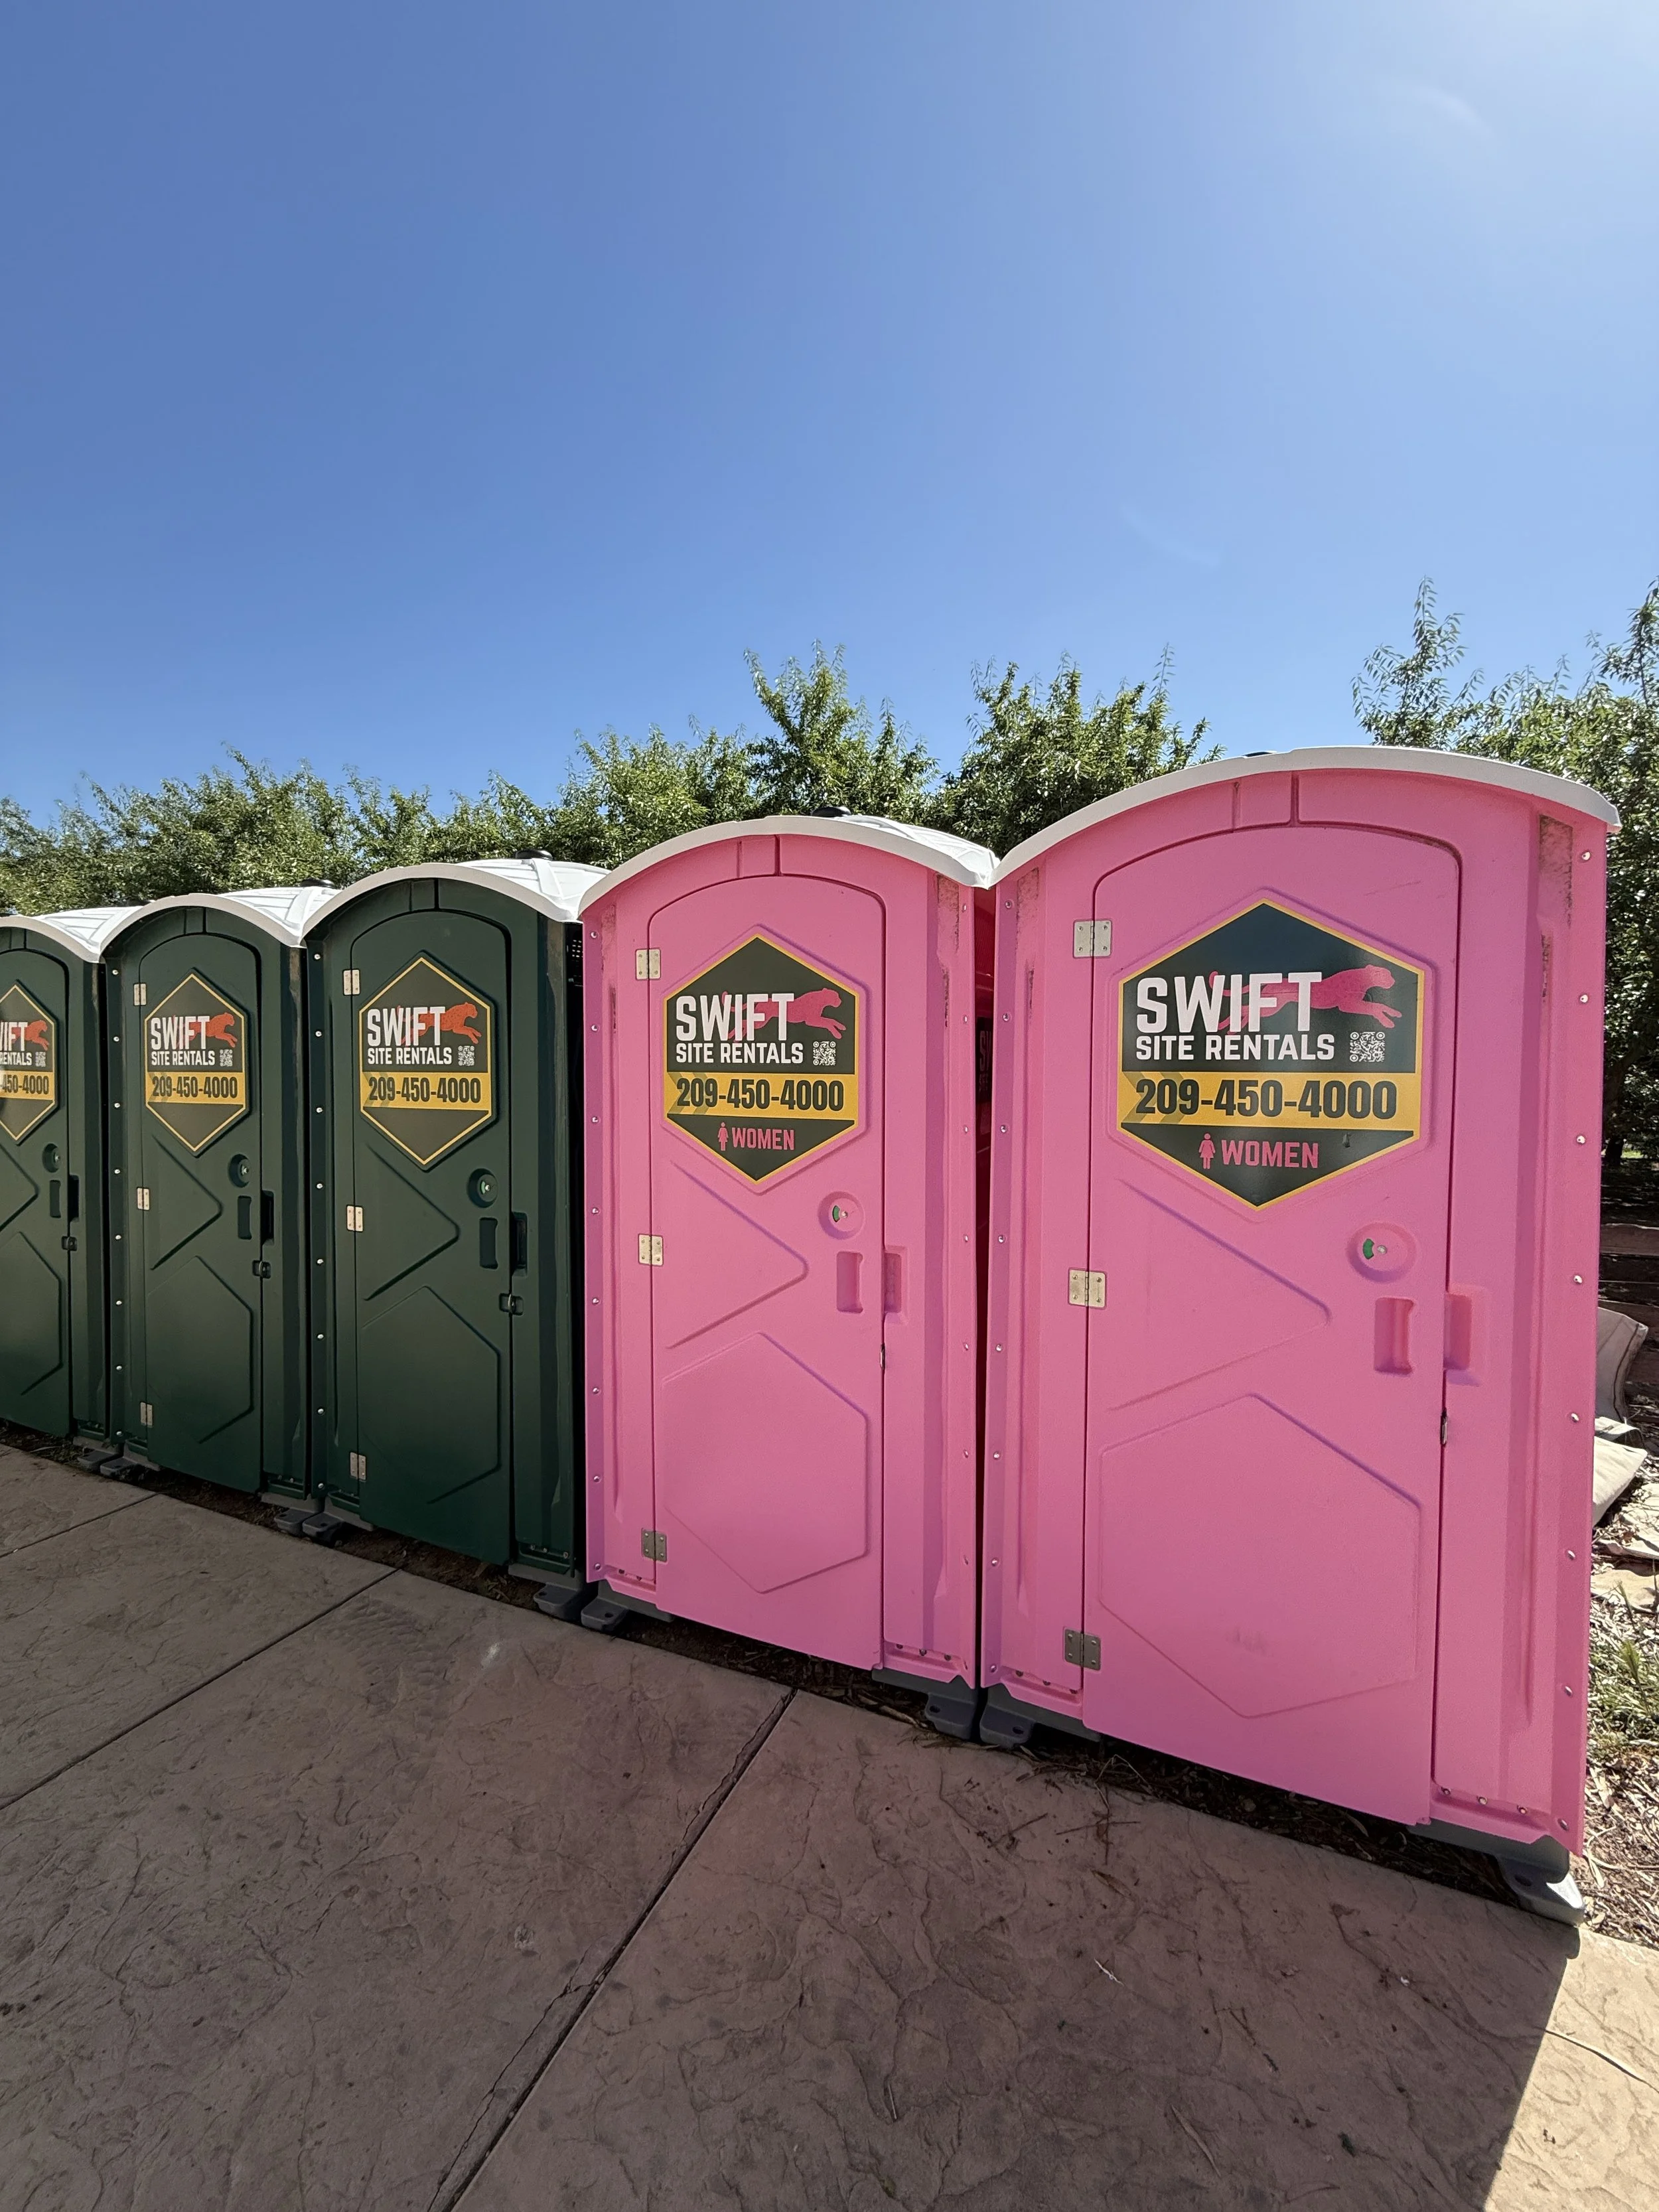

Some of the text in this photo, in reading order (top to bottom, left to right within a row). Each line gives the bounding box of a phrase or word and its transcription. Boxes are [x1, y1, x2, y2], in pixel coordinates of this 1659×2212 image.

[676, 993, 794, 1042] SWIFT
[1136, 972, 1323, 1034] SWIFT
[0, 1021, 29, 1052] IFT
[151, 1015, 210, 1050] SWIFT
[367, 1006, 446, 1047] SWIFT
[151, 1050, 216, 1066] SITE RENTALS
[367, 1046, 453, 1065] SITE RENTALS
[676, 1042, 804, 1065] SITE RENTALS
[1135, 1033, 1335, 1061] SITE RENTALS
[152, 1076, 238, 1098] 209-450-4000
[368, 1076, 482, 1104] 209-450-4000
[676, 1078, 844, 1112] 209-450-4000
[1135, 1078, 1398, 1120] 209-450-4000
[731, 1126, 795, 1151] WOMEN
[1221, 1139, 1319, 1169] WOMEN
